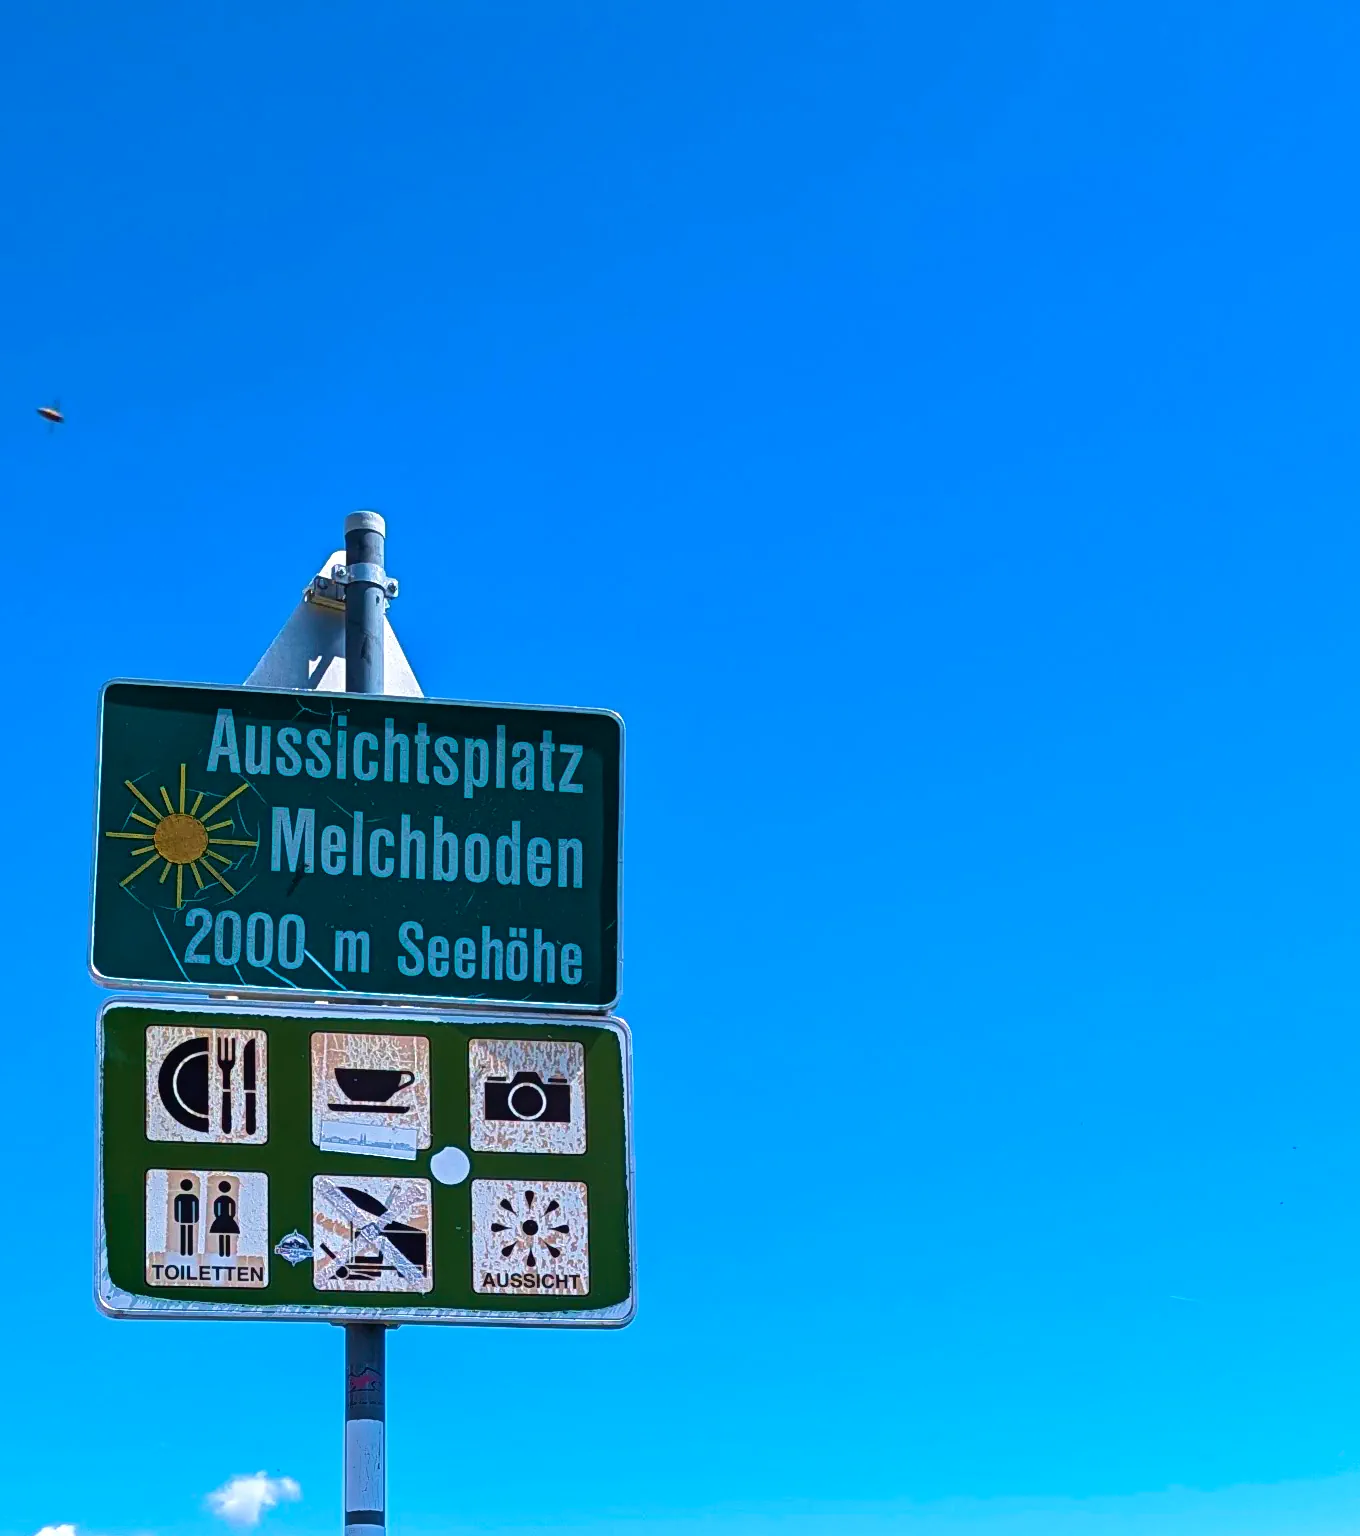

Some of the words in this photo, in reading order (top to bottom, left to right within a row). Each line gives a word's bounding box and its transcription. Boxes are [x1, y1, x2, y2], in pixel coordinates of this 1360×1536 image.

[206, 708, 584, 799] Aussichtsplatz
[270, 806, 583, 889] Melchboden
[184, 908, 306, 970] 2000
[334, 930, 370, 973] m
[397, 920, 582, 985] Seehöhe
[151, 1263, 264, 1283] TOILETTEN
[482, 1271, 581, 1290] AUSSICHT
